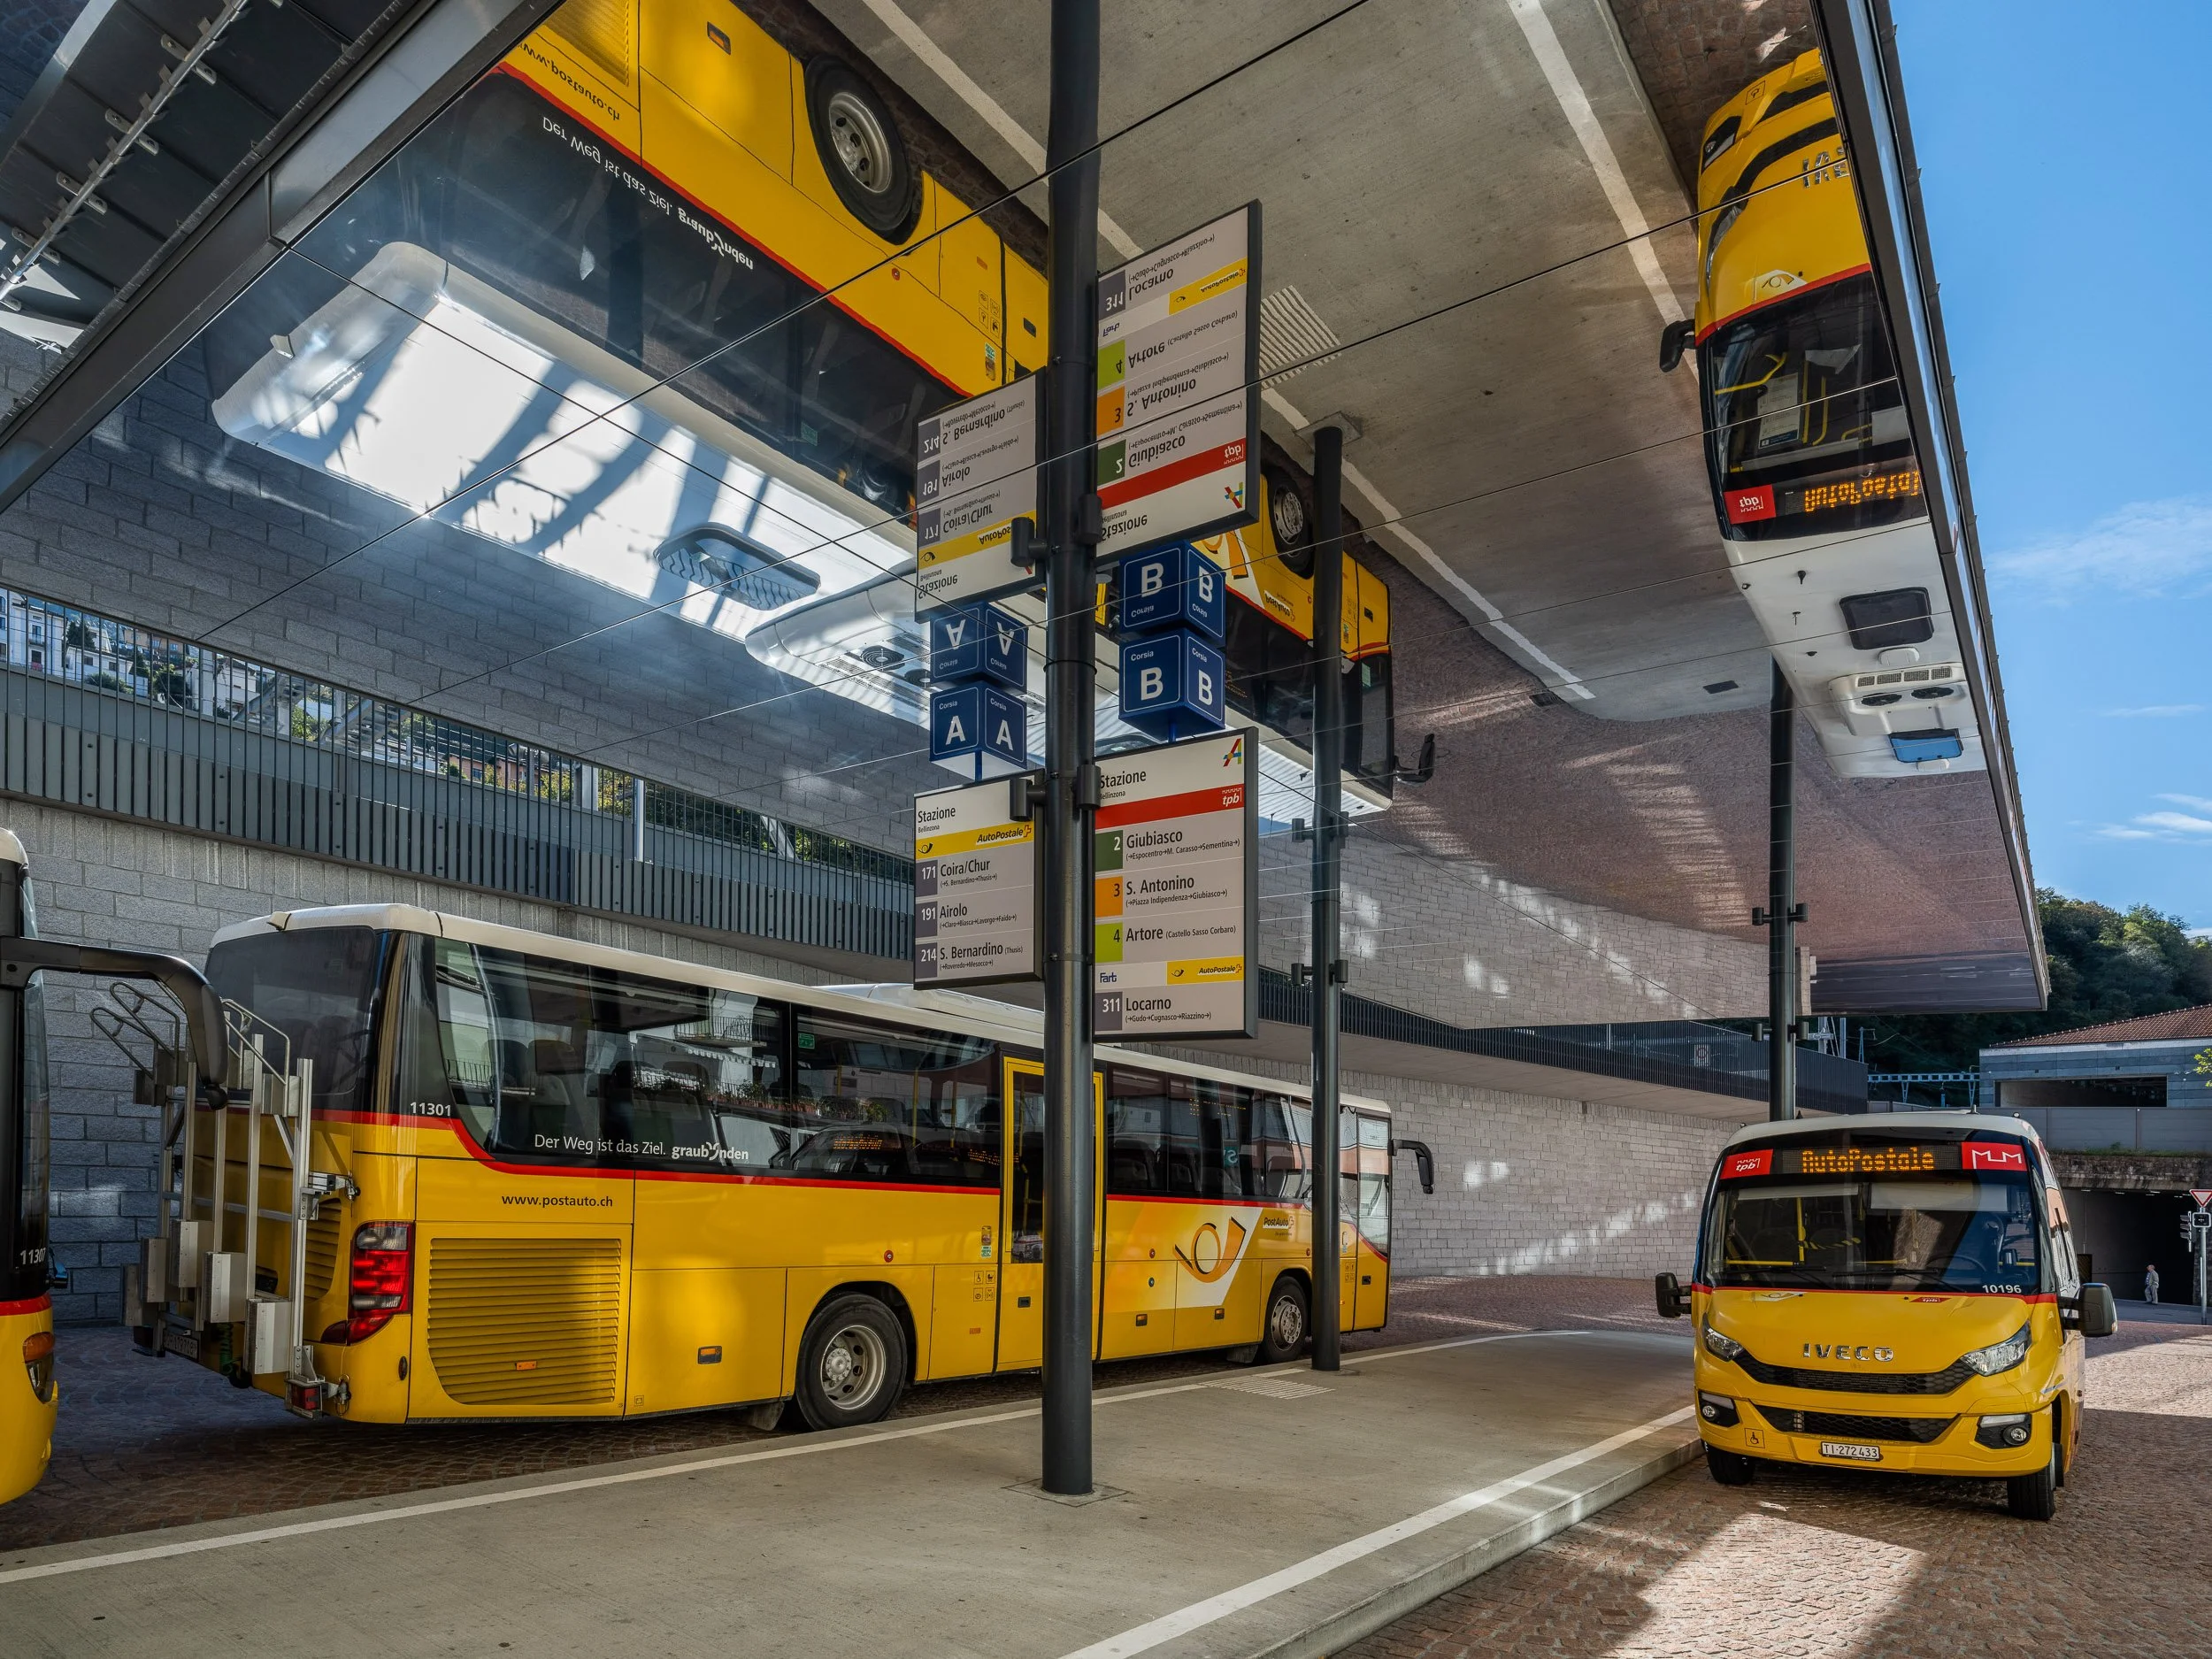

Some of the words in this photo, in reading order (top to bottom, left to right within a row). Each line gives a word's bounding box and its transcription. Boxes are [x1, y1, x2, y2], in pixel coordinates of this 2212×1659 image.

[1131, 649, 1155, 661] Corsia
[1192, 647, 1208, 663] Corsia
[1141, 666, 1164, 701] B
[1198, 669, 1213, 706] B
[939, 701, 958, 710] Corsia
[990, 697, 1007, 711] Corsia
[945, 715, 966, 746] A
[995, 719, 1013, 751] A
[1100, 771, 1147, 789] Stazione
[1222, 793, 1240, 807] tpb
[918, 807, 956, 823] Stazione
[918, 825, 940, 833] Bellinzona
[977, 827, 1023, 843] AutoPostale
[1114, 837, 1121, 851] 2
[1126, 830, 1183, 849] Giubiasco
[1176, 845, 1198, 855] Carasso
[922, 866, 936, 879] 171
[940, 858, 991, 877] Coira/Chur
[1113, 883, 1120, 897] 3
[1125, 881, 1136, 895] S.
[1141, 875, 1194, 894] Antonino
[1150, 894, 1188, 904] Indipendenza
[921, 907, 936, 920] 191
[940, 902, 968, 919] Airolo
[1113, 929, 1120, 942] 4
[1125, 927, 1164, 942] Artore
[1165, 930, 1191, 939] (Castello
[1210, 926, 1236, 934] Corbaro)
[921, 949, 936, 962] 214
[940, 948, 948, 960] S.
[951, 942, 1003, 959] Bernardino
[1005, 946, 1023, 955] (Thusis)
[1102, 997, 1121, 1013] 311
[1125, 998, 1171, 1011] Locarno
[409, 1102, 452, 1118] 11301
[534, 1133, 560, 1149] Der
[563, 1136, 594, 1156] Weg
[597, 1138, 613, 1153] ist
[616, 1139, 639, 1154] das
[641, 1141, 666, 1156] Ziel.
[1735, 1162, 1756, 1172] tpb
[1801, 1148, 1935, 1173] AutoPostale
[502, 1194, 613, 1209] www.postauto.ch
[1263, 1217, 1288, 1226] PostAuto
[1982, 1284, 2022, 1294] 10196
[1802, 1343, 1894, 1363] IVECO
